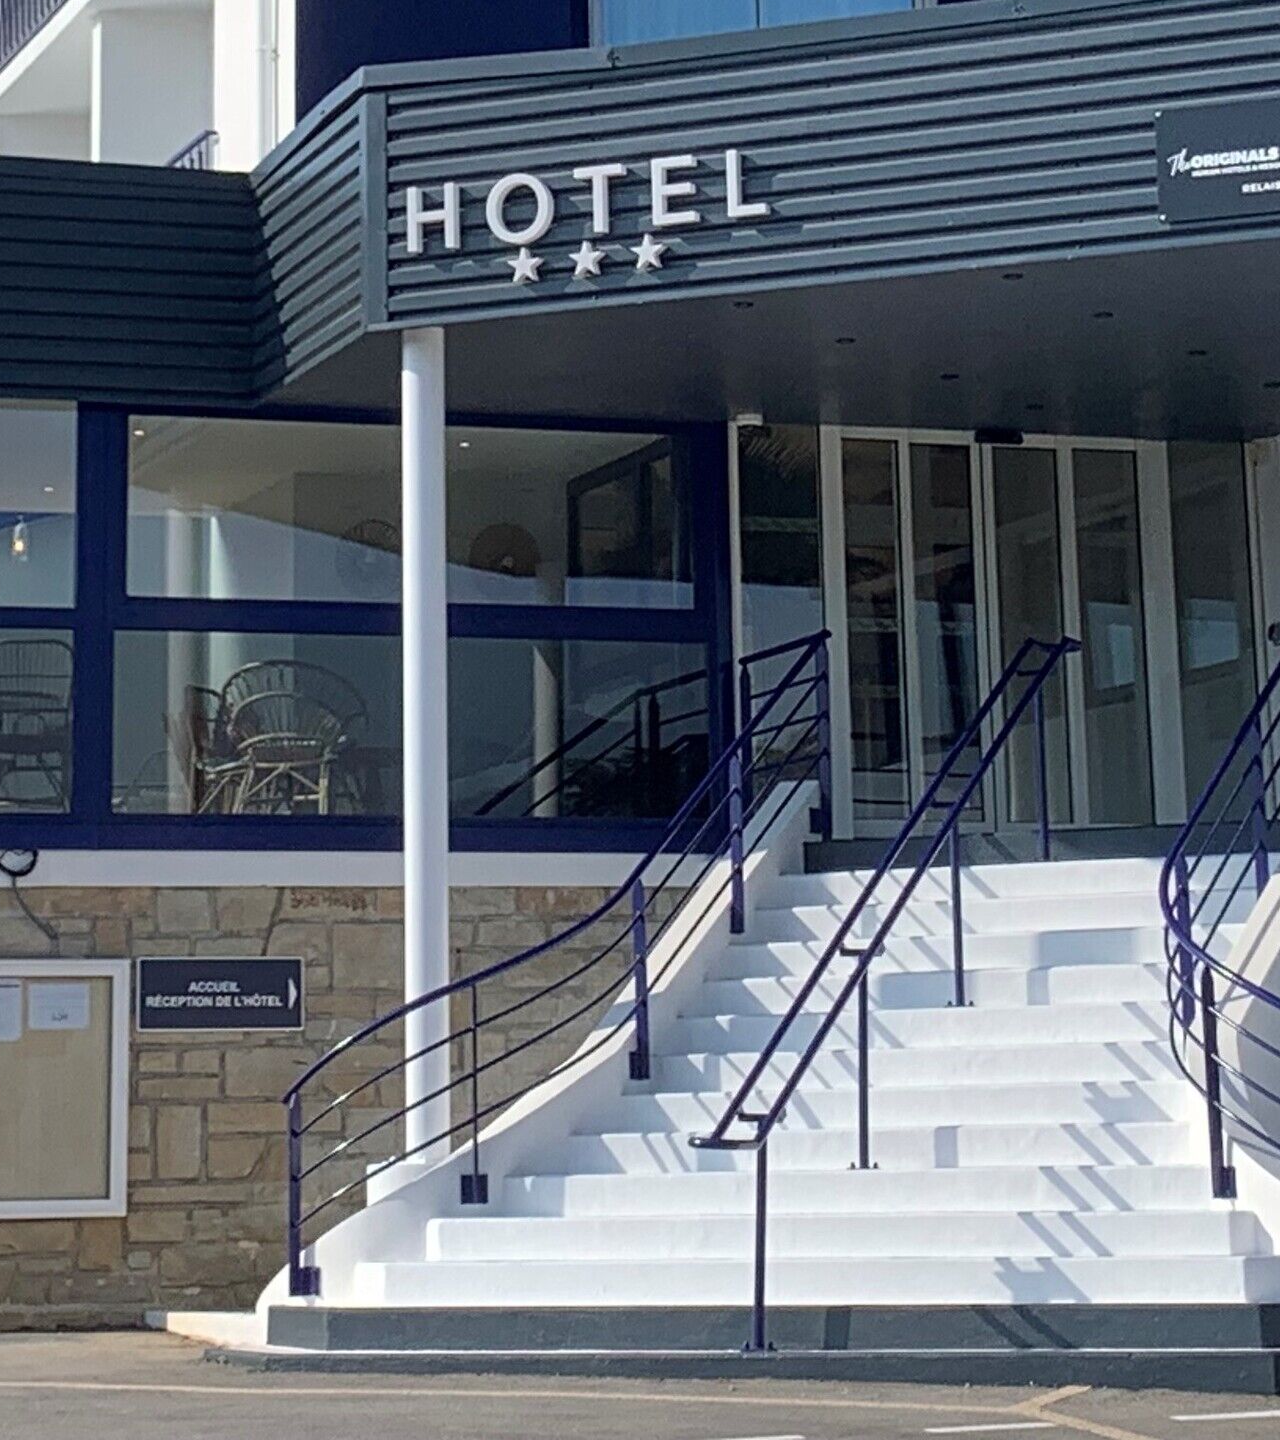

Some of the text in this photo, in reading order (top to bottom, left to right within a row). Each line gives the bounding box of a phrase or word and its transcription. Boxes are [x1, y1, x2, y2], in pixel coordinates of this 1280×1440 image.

[1190, 146, 1280, 169] ORIGINALS
[406, 149, 771, 253] HOTEL
[188, 981, 241, 993] ACCUEIL
[145, 994, 214, 1008] RÉCEPTION
[215, 995, 232, 1007] DE
